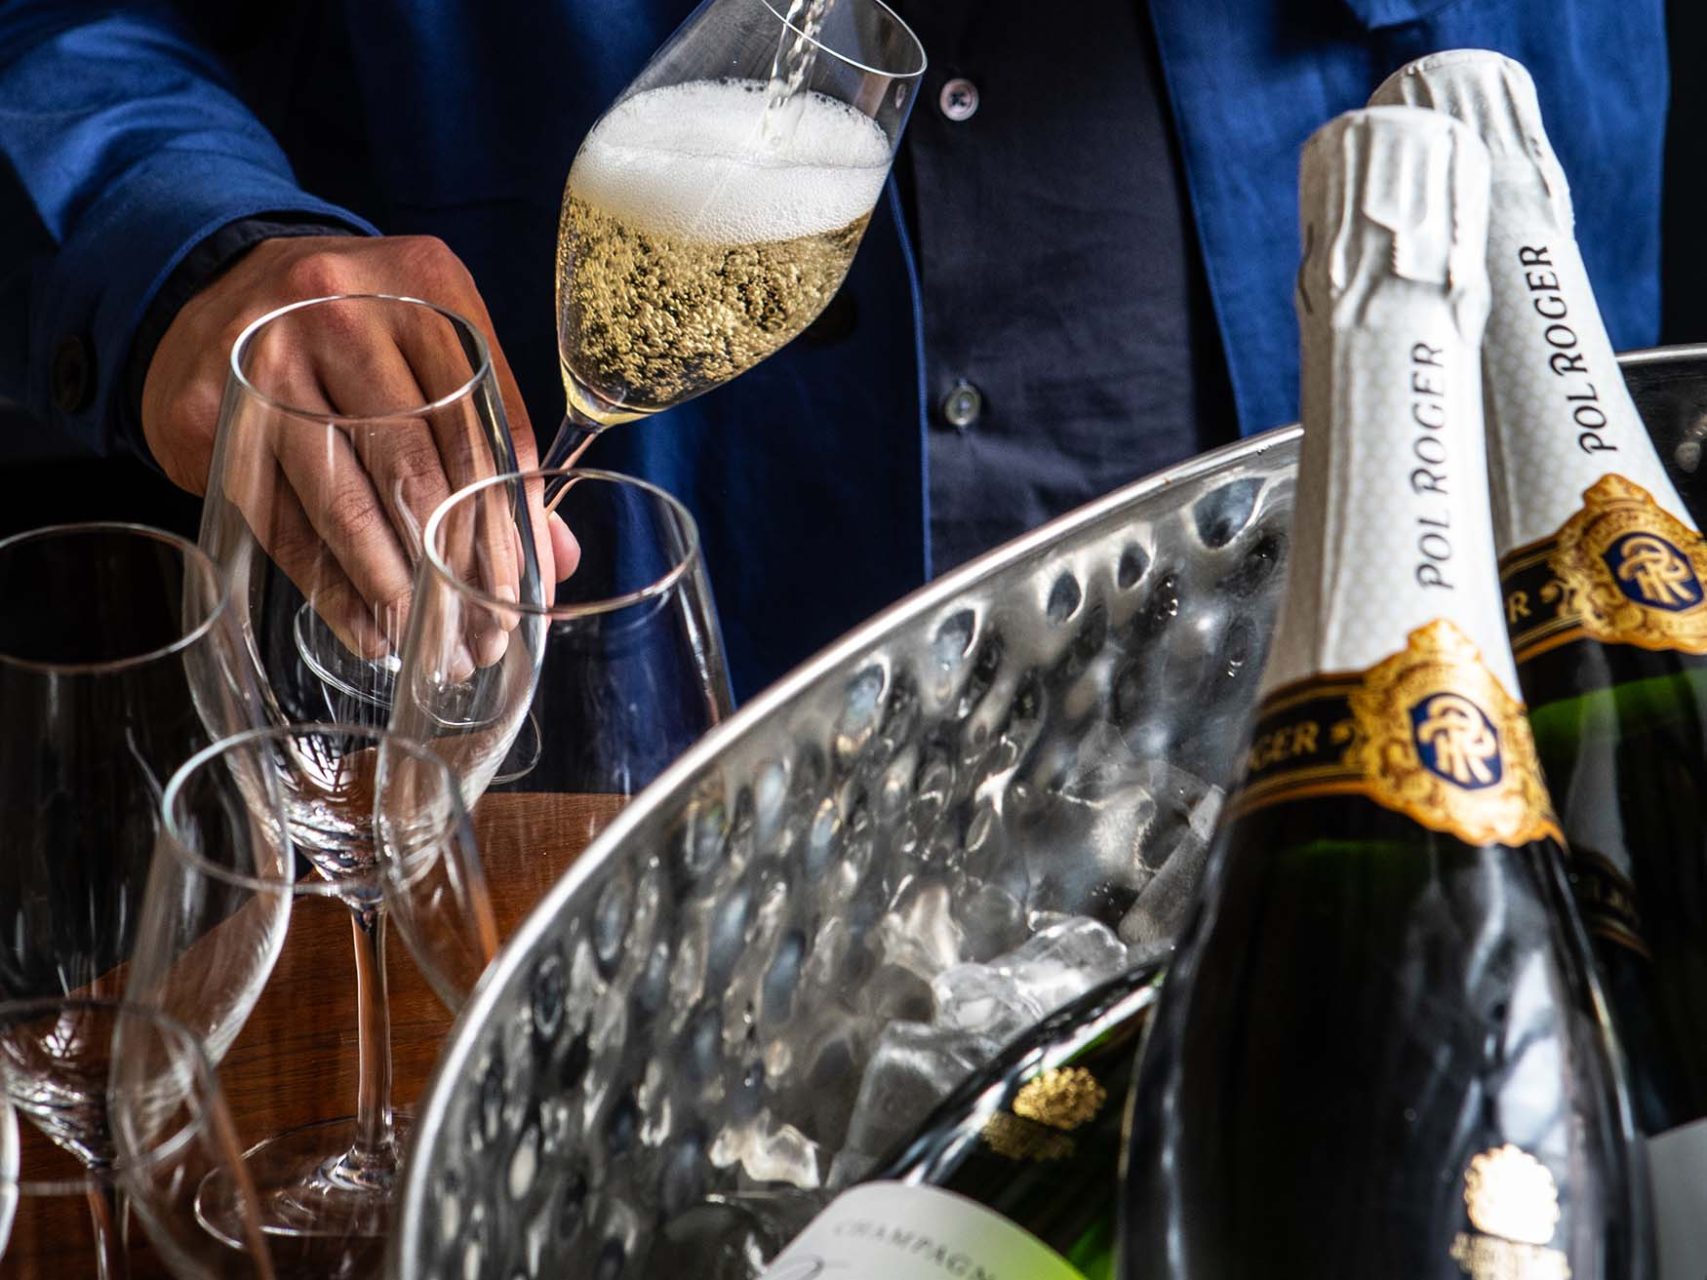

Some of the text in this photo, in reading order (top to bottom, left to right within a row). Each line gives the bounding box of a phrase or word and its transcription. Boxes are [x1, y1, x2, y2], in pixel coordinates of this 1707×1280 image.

[1518, 245, 1619, 455] POL ROGER
[1410, 342, 1456, 590] POL ROGER
